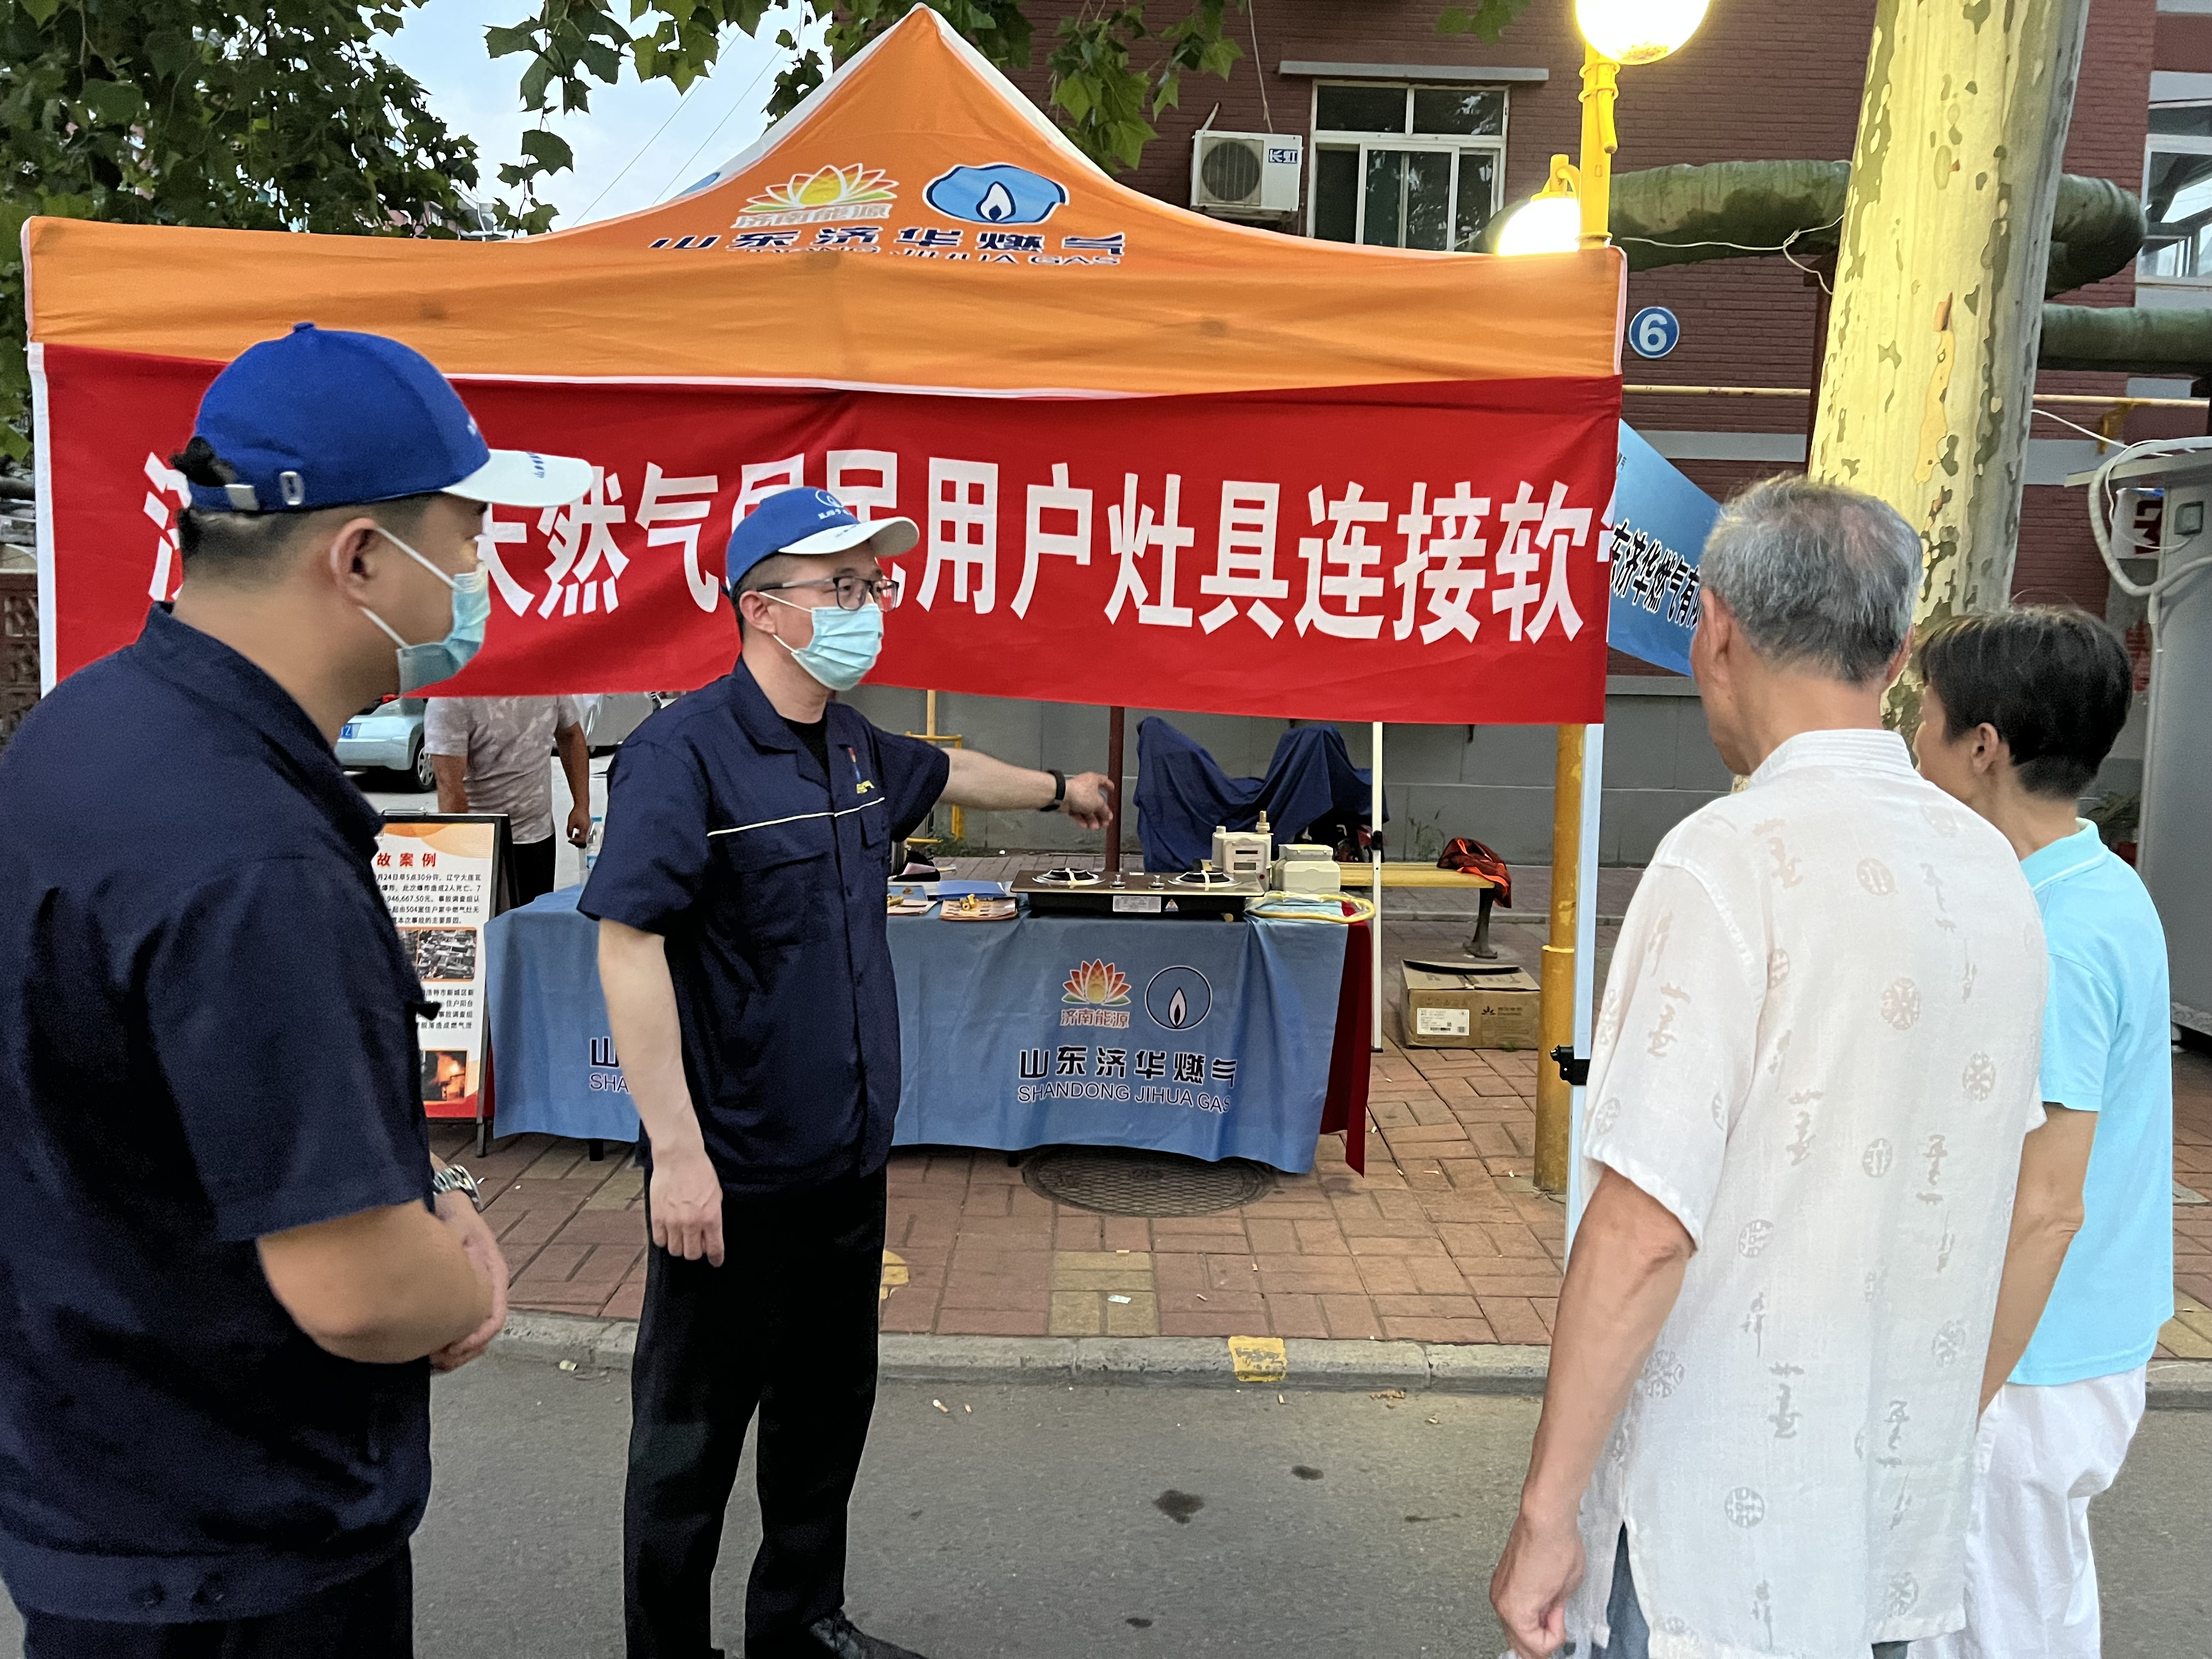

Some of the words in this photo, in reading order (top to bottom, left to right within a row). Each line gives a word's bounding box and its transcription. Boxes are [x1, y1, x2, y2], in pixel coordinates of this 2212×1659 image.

[1269, 149, 1297, 163] 长虹
[1639, 313, 1667, 352] 6
[377, 853, 436, 867] 故案例
[1060, 1009, 1130, 1028] 济南能源
[1019, 1045, 1237, 1087] 山东济华燃气
[590, 1073, 631, 1094] SHA
[1018, 1081, 1130, 1103] SHANDONG
[1135, 1086, 1194, 1107] JIHUA
[1197, 1093, 1231, 1114] GAS
